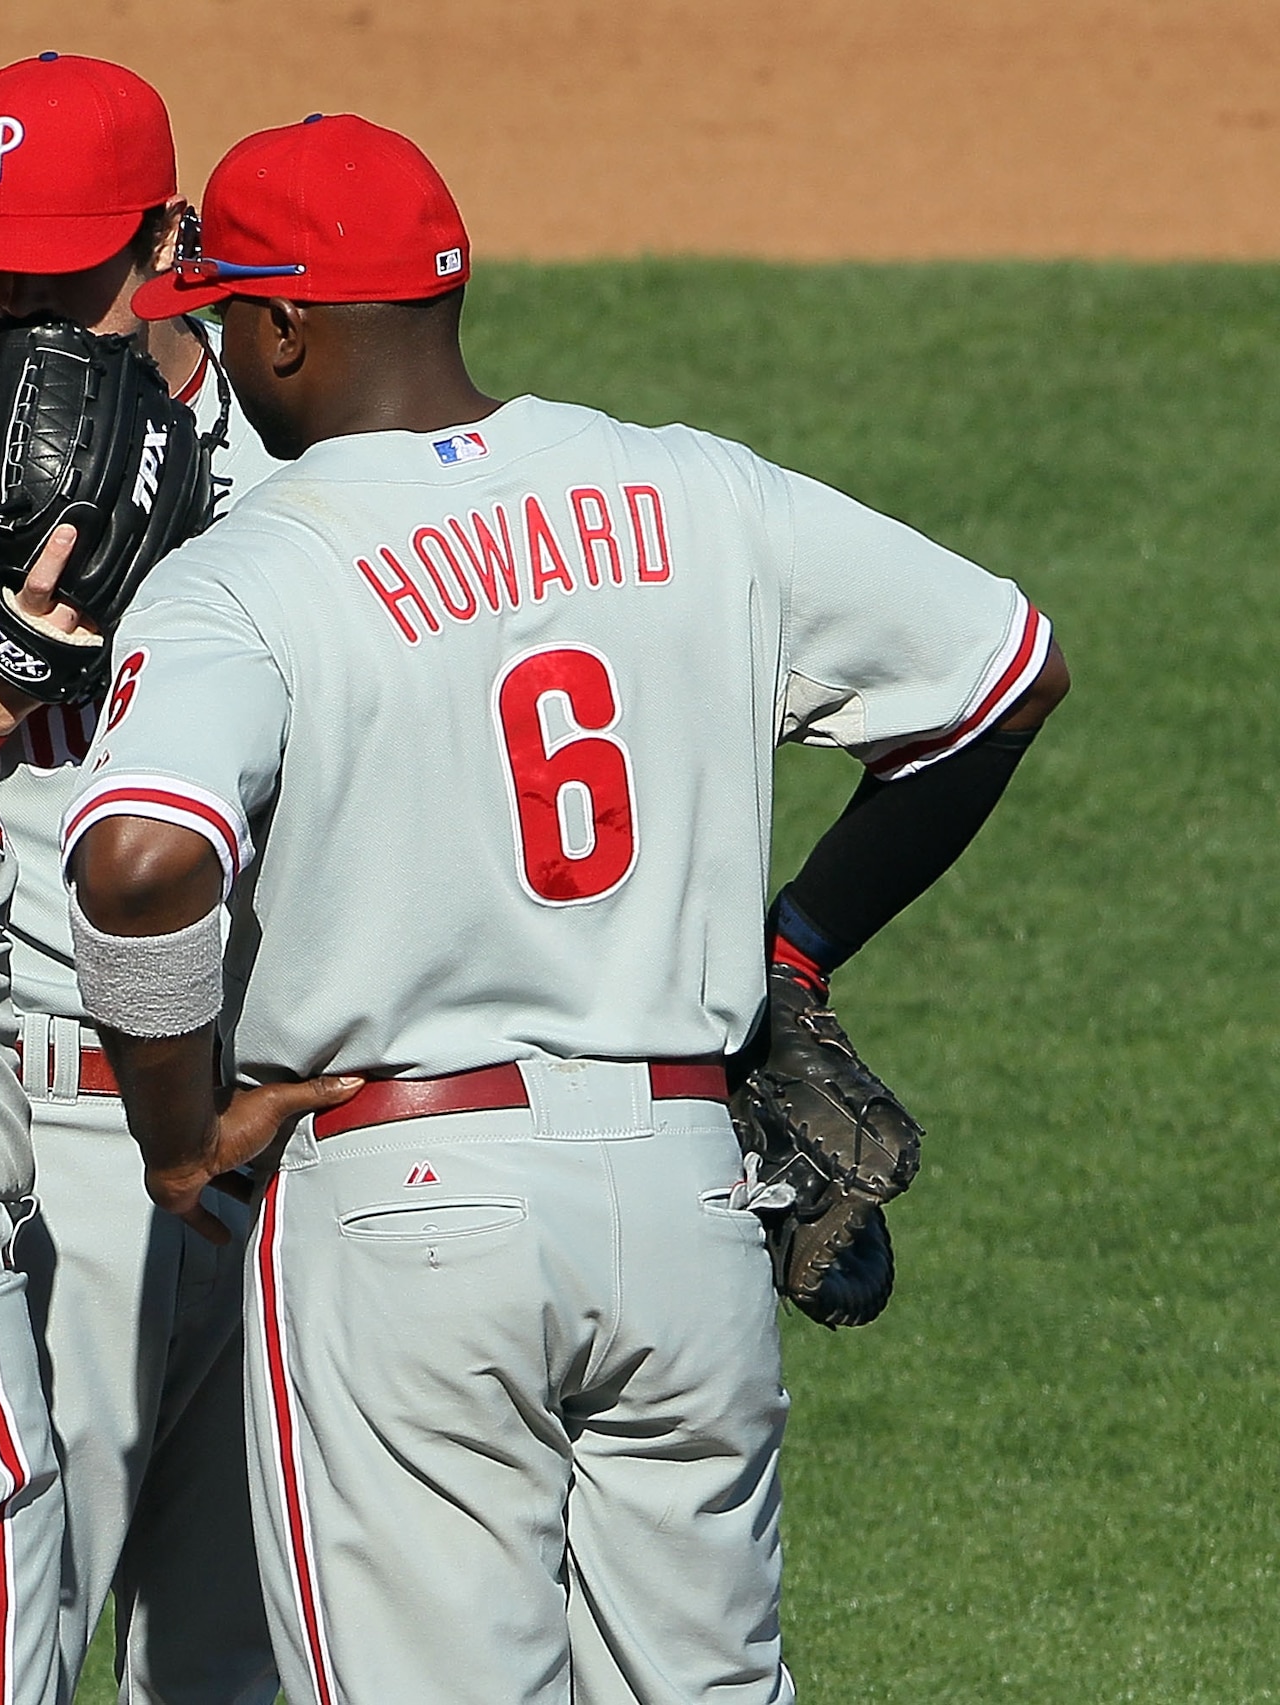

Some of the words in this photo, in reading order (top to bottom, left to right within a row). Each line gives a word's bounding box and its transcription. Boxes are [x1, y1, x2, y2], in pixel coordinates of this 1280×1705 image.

[131, 418, 168, 515] TPX
[353, 482, 675, 647] HOWARD
[107, 646, 151, 733] 6
[491, 641, 640, 908] 6
